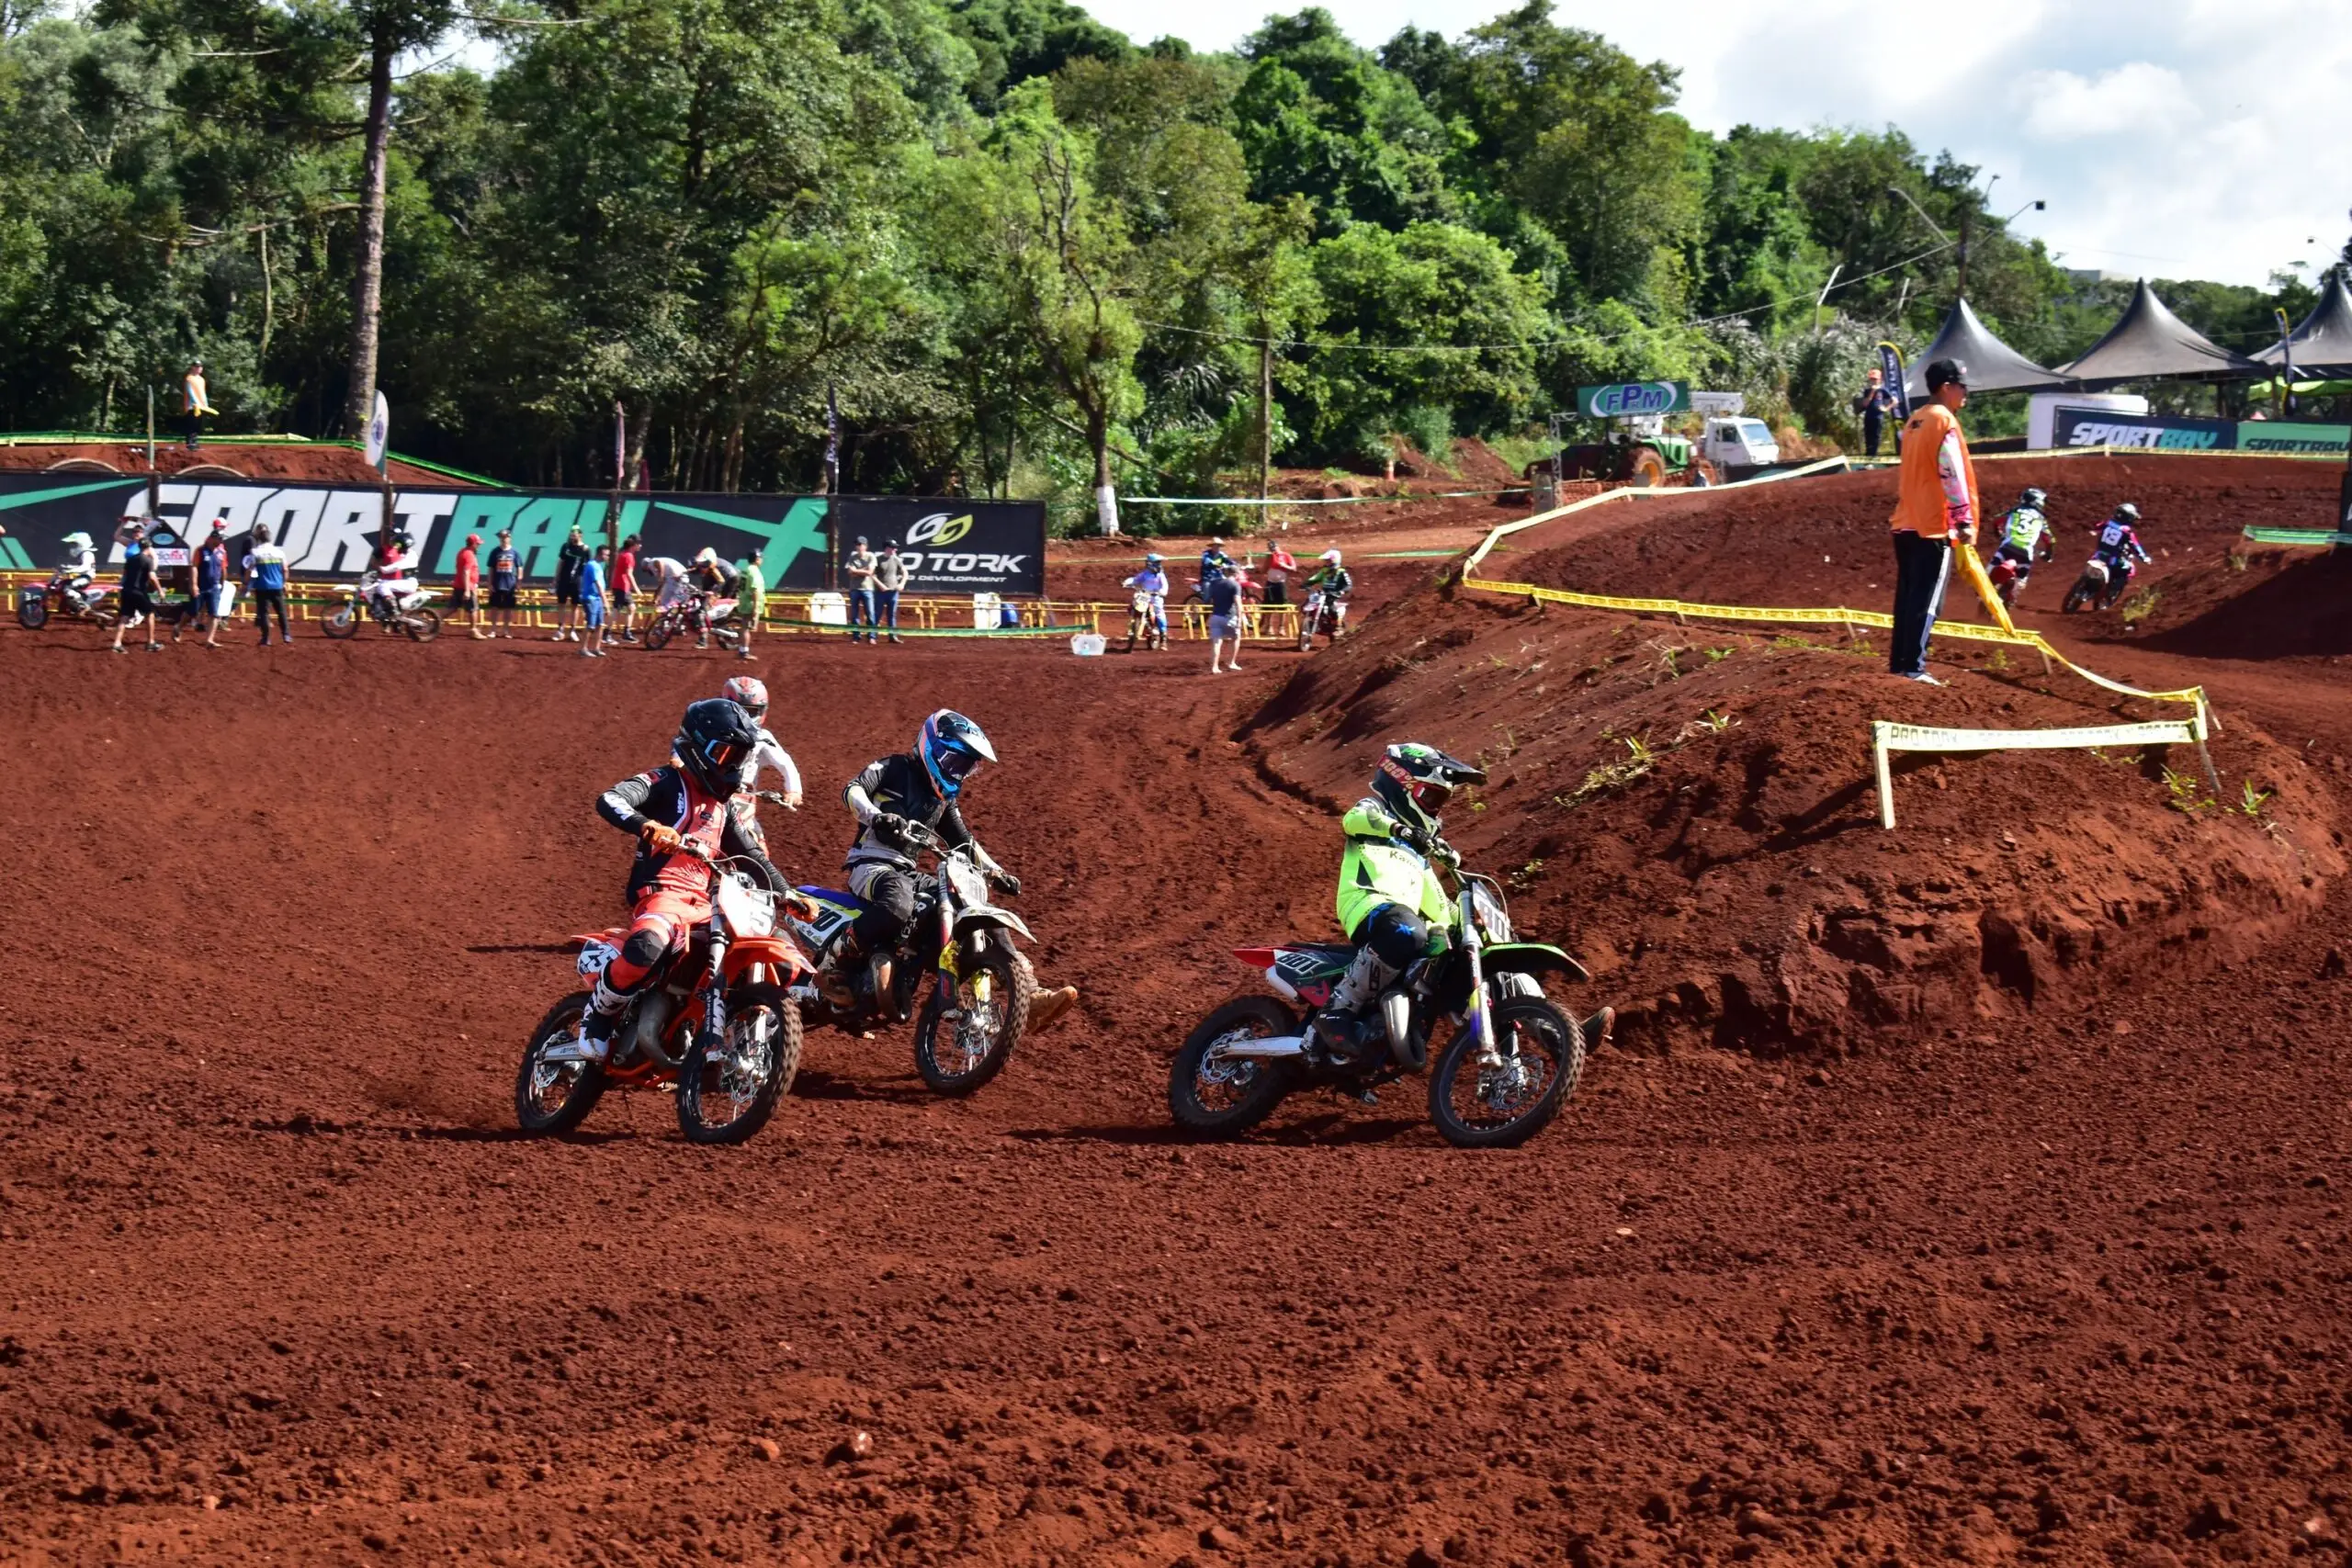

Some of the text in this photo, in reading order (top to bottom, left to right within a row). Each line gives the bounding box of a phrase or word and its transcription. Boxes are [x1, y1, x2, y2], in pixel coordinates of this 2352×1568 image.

[2069, 423, 2219, 449] SPORTBAY
[927, 552, 1027, 573] TORK
[1380, 758, 1417, 789] 100%
[1275, 952, 1323, 974] 801
